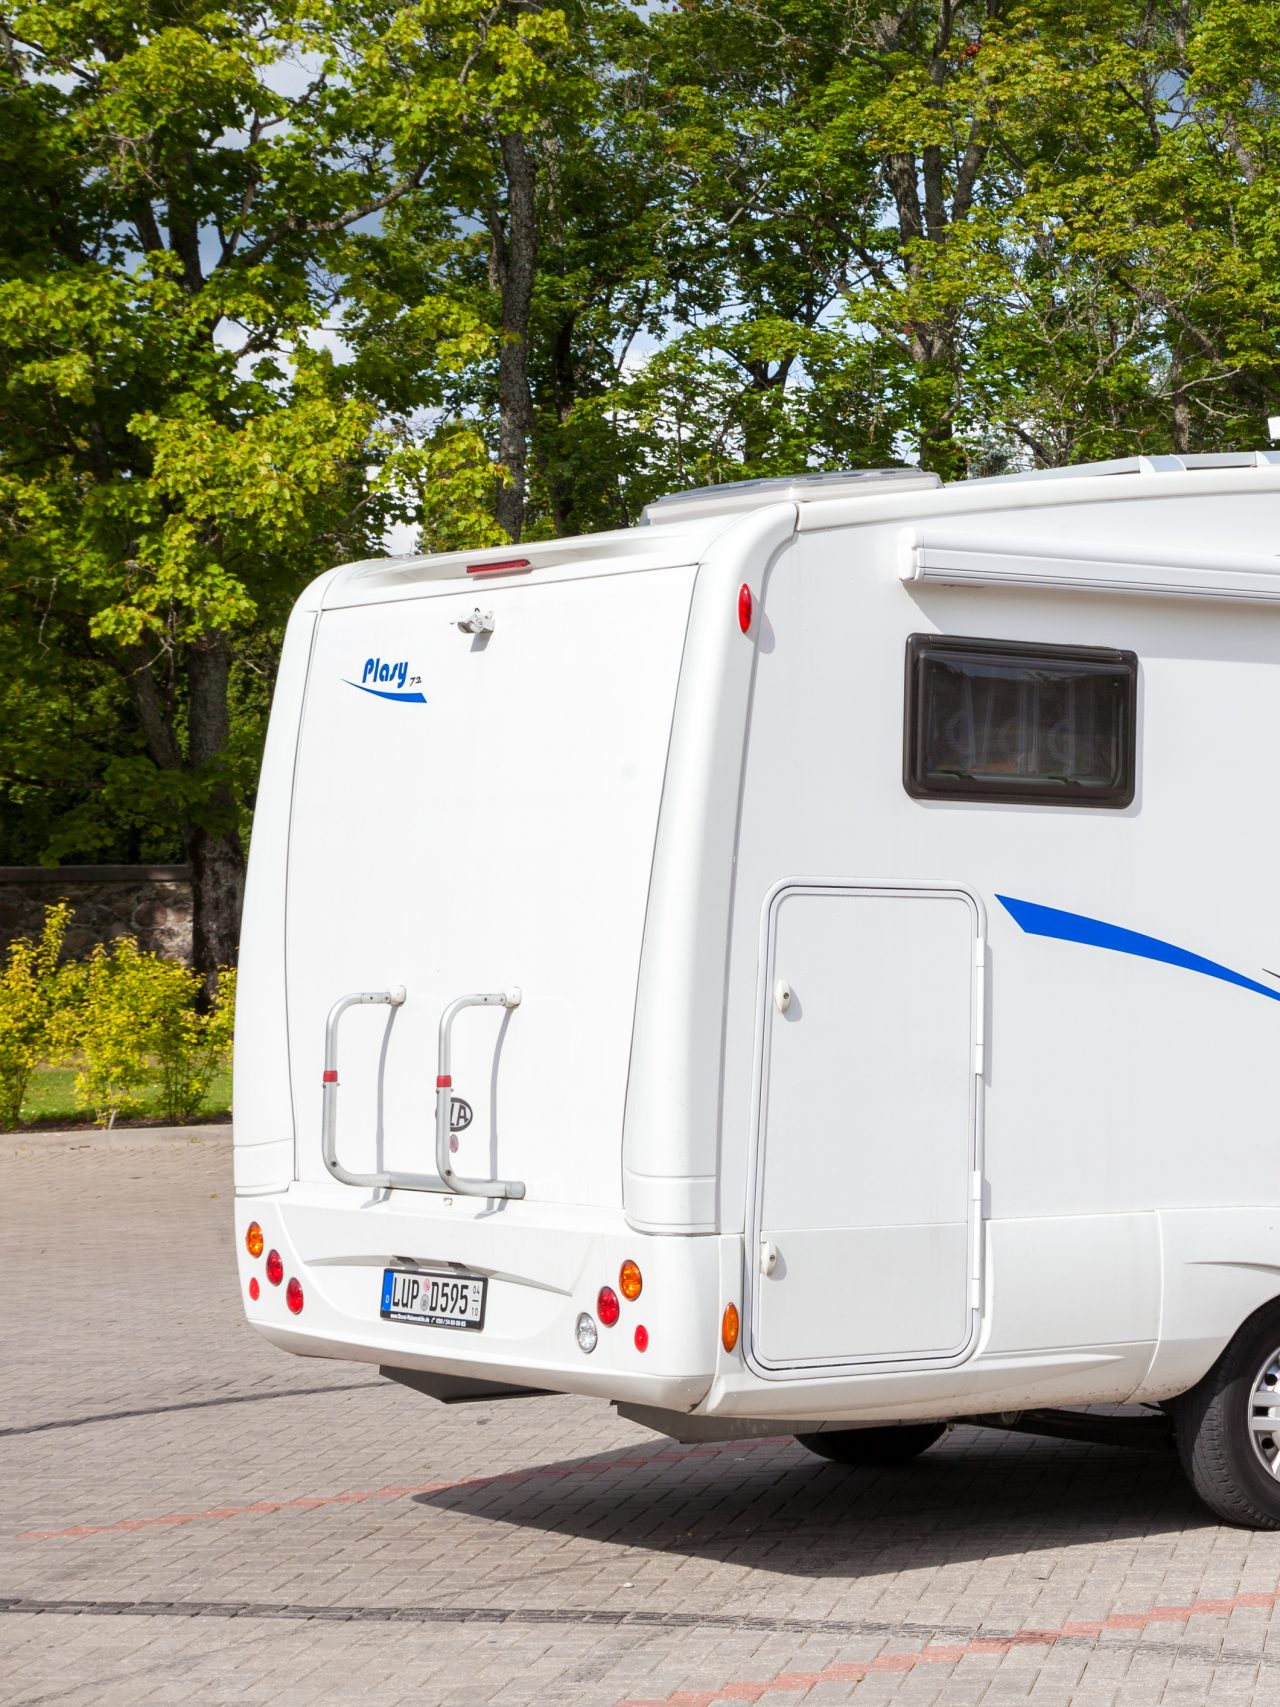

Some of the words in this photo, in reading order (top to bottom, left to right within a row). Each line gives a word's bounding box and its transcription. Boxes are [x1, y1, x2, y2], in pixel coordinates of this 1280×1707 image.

[362, 657, 408, 688] Plasy
[409, 676, 422, 687] 72
[472, 1285, 480, 1295] 04
[385, 1294, 390, 1304] D
[392, 1276, 420, 1309] LUP
[429, 1281, 469, 1315] D595
[471, 1307, 479, 1317] 10
